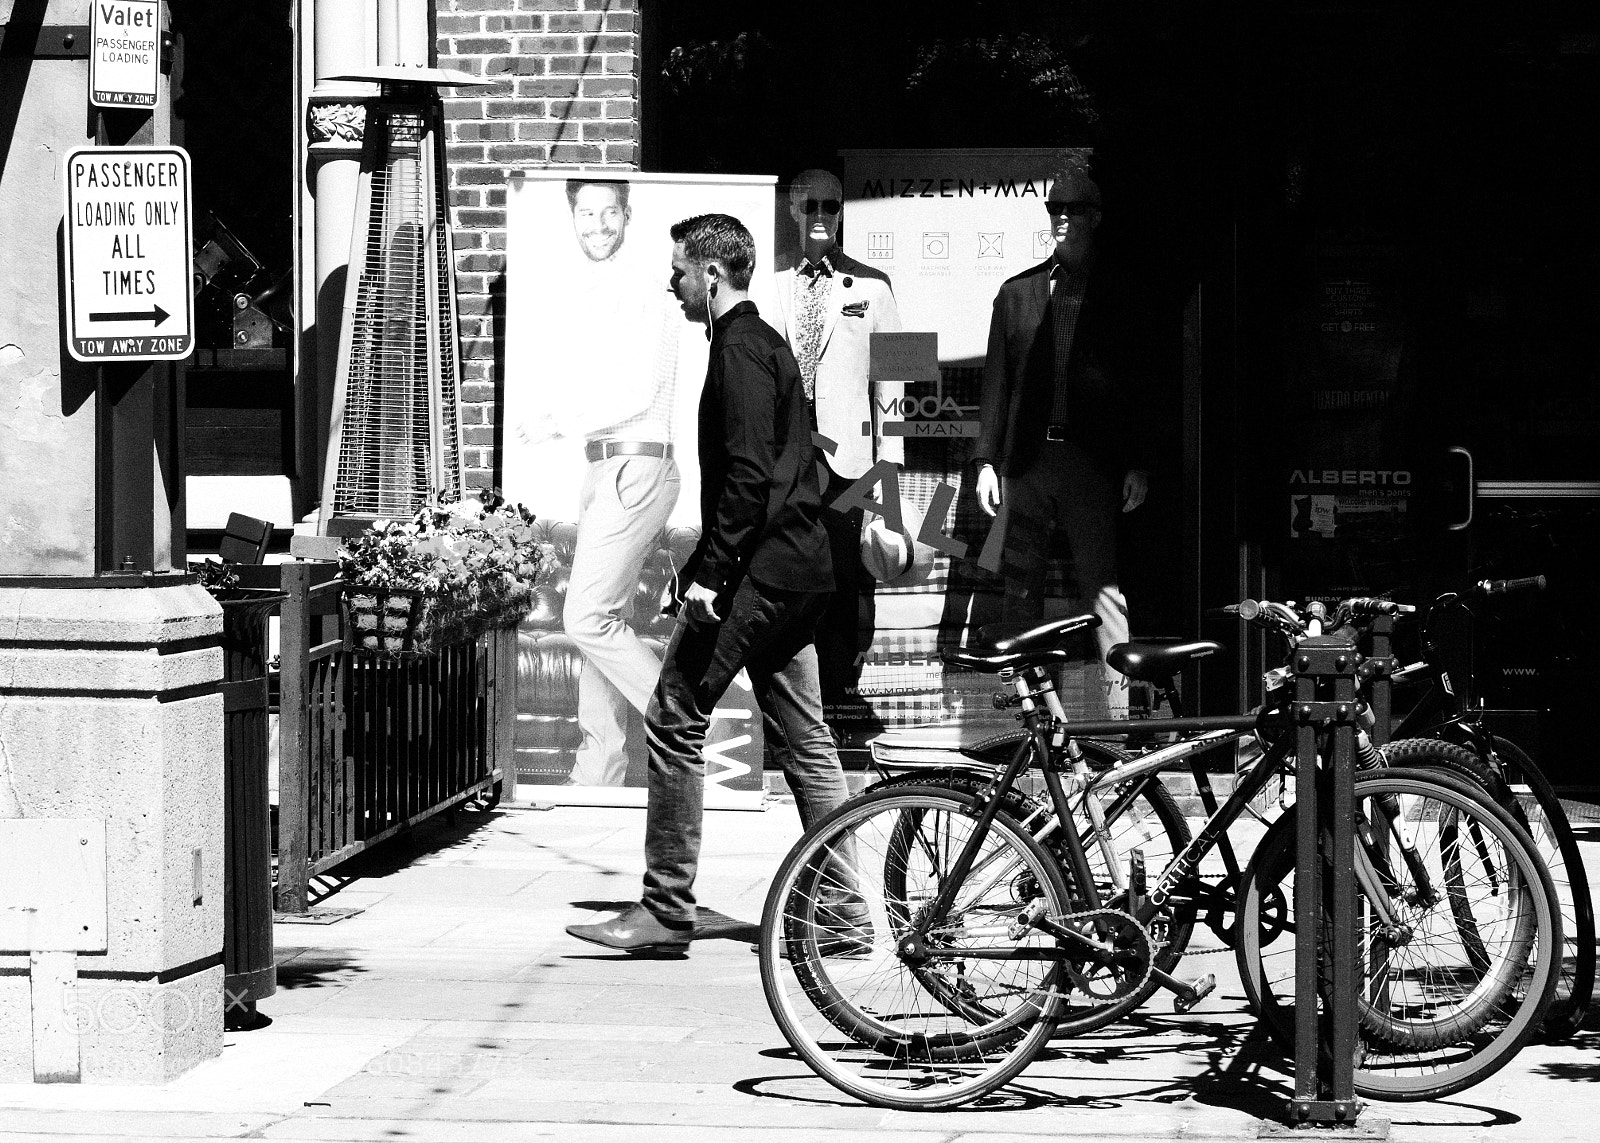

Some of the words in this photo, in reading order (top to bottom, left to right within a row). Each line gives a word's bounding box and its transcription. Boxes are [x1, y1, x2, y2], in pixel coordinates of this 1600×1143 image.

[101, 4, 153, 28] Valet
[97, 37, 155, 51] PASSENGER
[102, 52, 149, 65] LOADING
[96, 92, 112, 102] TOW
[113, 93, 133, 103] AWY
[135, 94, 155, 105] ZONE
[76, 162, 179, 188] PASSENGER
[861, 178, 1050, 198] MIZZEN+MAI
[77, 202, 136, 227] LOADING
[145, 201, 179, 226] ONLY
[111, 234, 146, 259] ALL
[102, 270, 156, 295] TIMES
[80, 340, 105, 354] TOW
[151, 338, 184, 352] ZONE
[915, 423, 963, 435] MAN
[1289, 470, 1412, 485] ALBERTO
[852, 651, 944, 667] ALBER
[1150, 830, 1220, 906] CRITICAL
